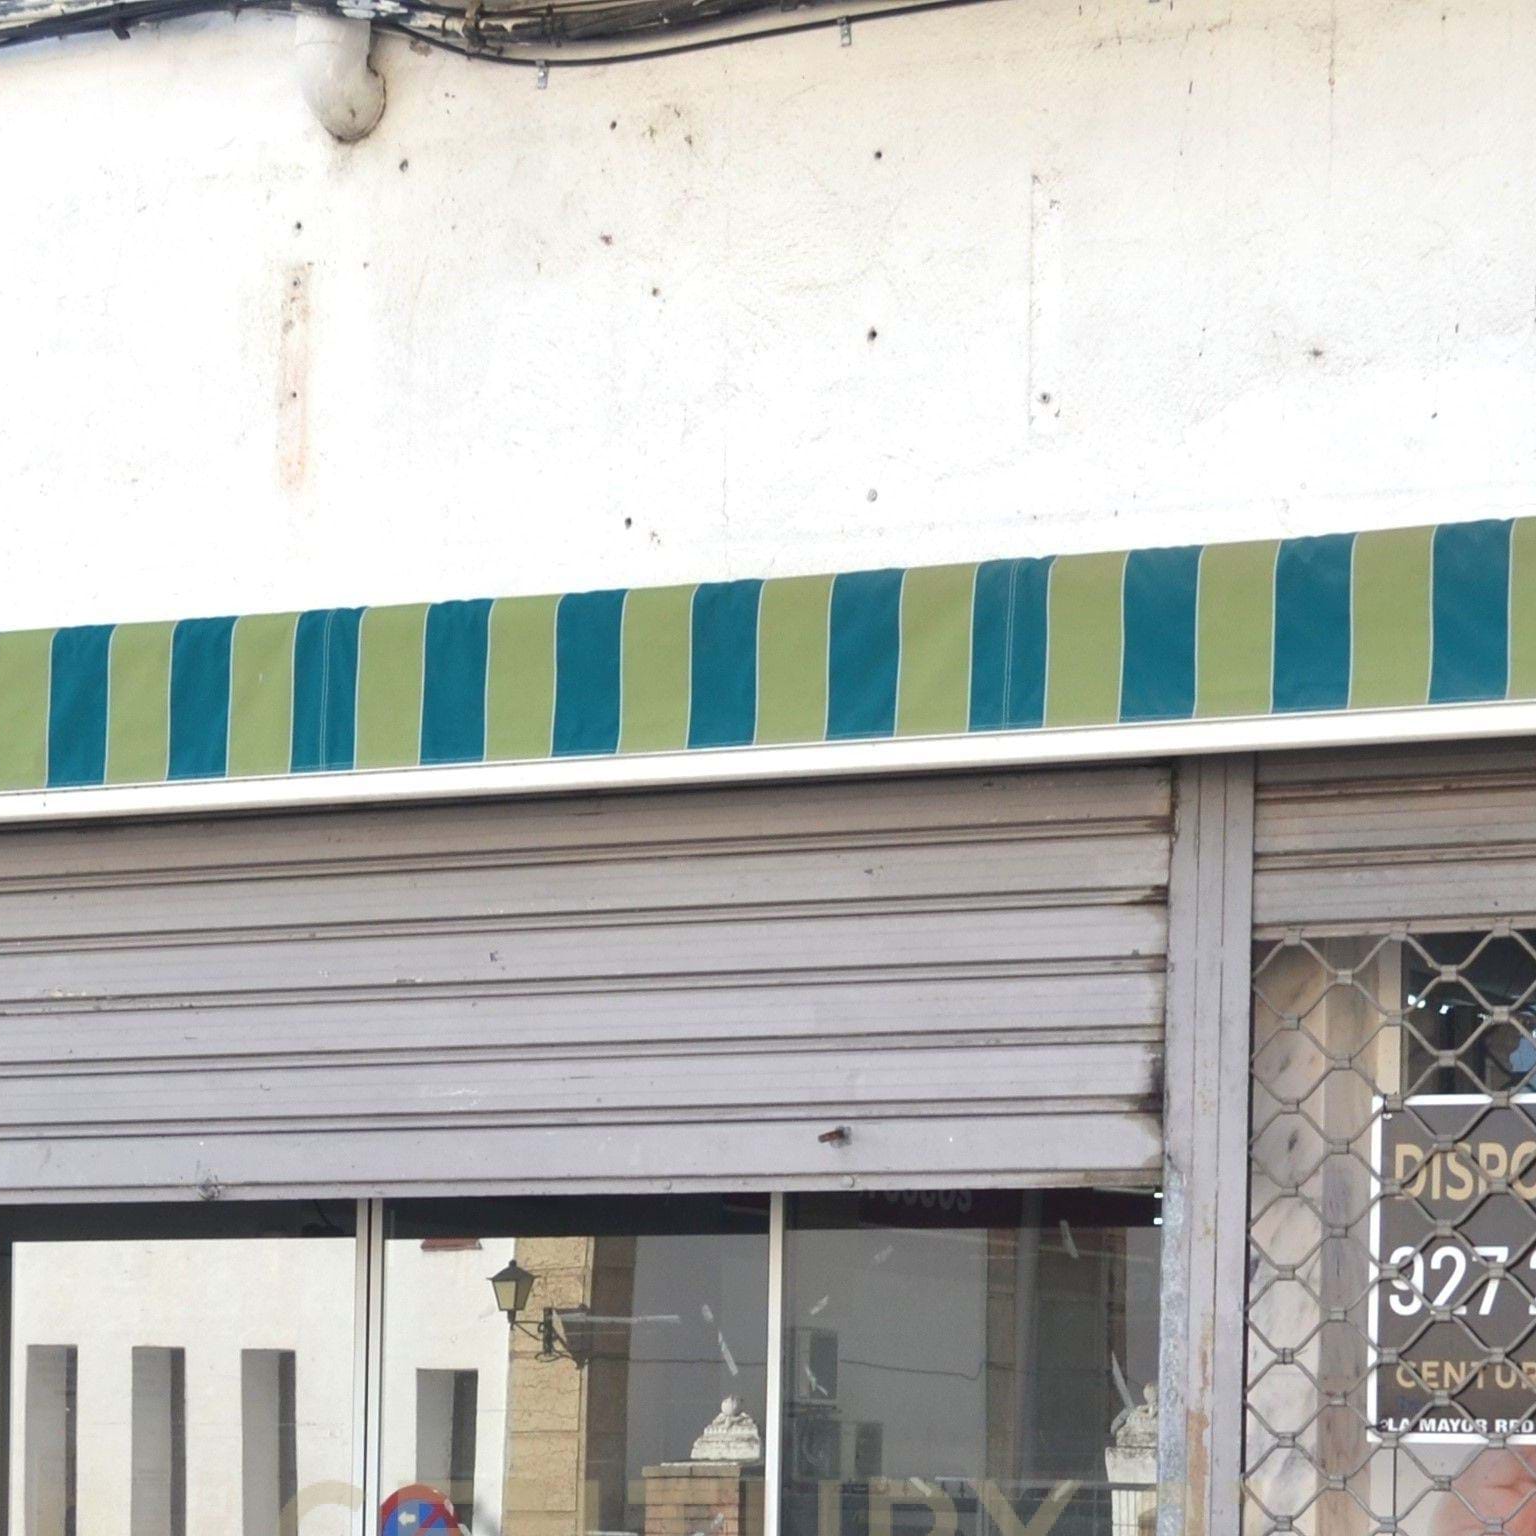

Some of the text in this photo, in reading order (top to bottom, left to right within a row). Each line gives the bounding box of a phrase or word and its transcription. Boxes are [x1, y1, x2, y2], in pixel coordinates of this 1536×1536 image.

[1389, 1245, 1509, 1316] 927
[1388, 1418, 1411, 1432] LA
[1419, 1418, 1488, 1433] MAYOR
[1495, 1419, 1535, 1434] RED
